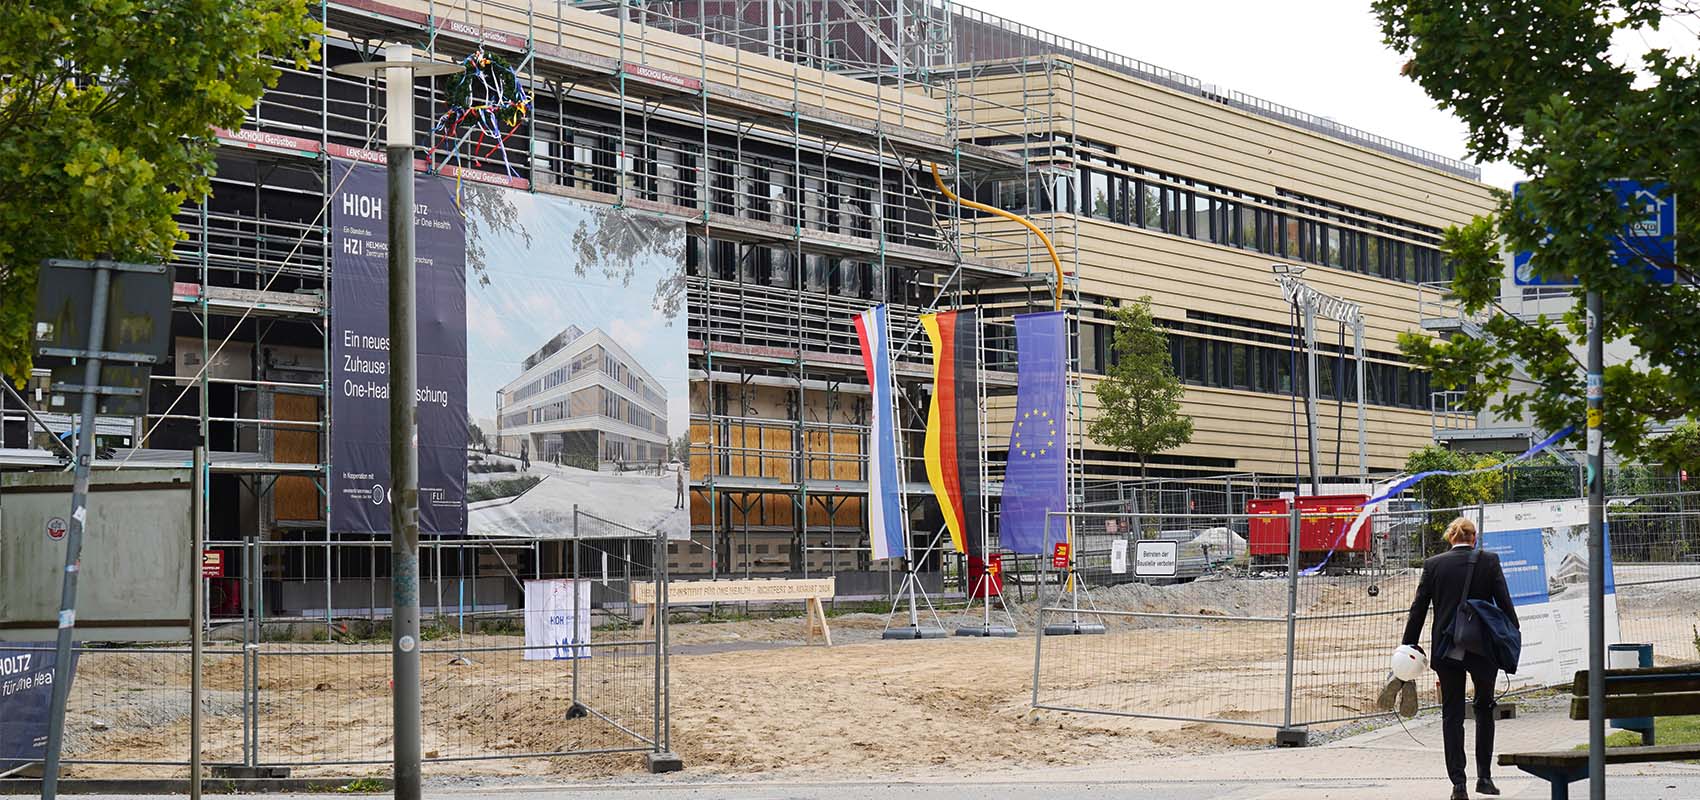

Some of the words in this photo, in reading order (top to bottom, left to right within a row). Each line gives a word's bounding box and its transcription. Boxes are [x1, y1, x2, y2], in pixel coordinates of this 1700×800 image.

[452, 167, 481, 180] LESCHOW
[343, 192, 382, 220] HIOH
[422, 217, 433, 228] One
[433, 220, 451, 230] Health
[343, 237, 362, 255] HZI
[366, 240, 388, 250] HELMHOL
[344, 330, 360, 348] Ein
[363, 335, 390, 350] neues
[344, 355, 386, 375] Zuhause
